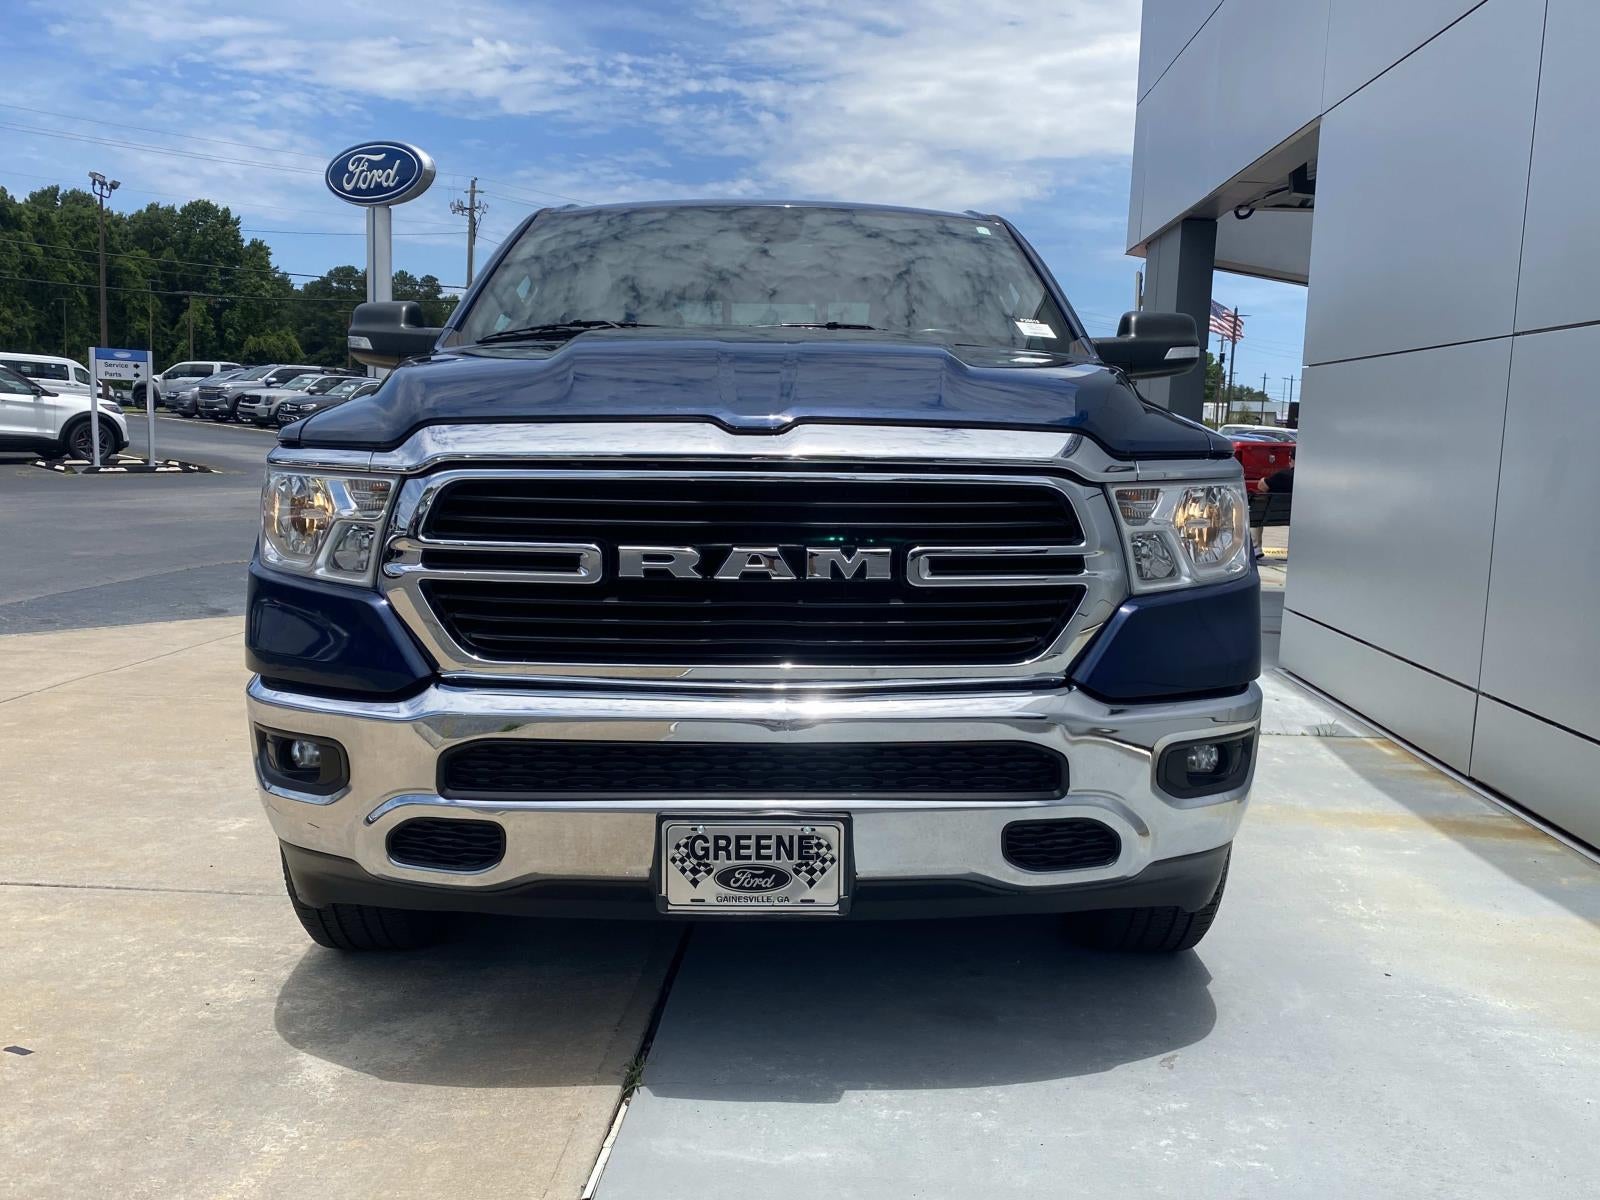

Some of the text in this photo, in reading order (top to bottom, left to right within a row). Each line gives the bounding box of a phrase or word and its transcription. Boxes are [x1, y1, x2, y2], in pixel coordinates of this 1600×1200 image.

[343, 153, 400, 190] Ford
[104, 361, 129, 369] Service
[618, 546, 892, 580] RAM
[689, 834, 816, 861] GREENE
[730, 869, 775, 888] Ford
[716, 895, 791, 904] GAINESVILLE, GA
